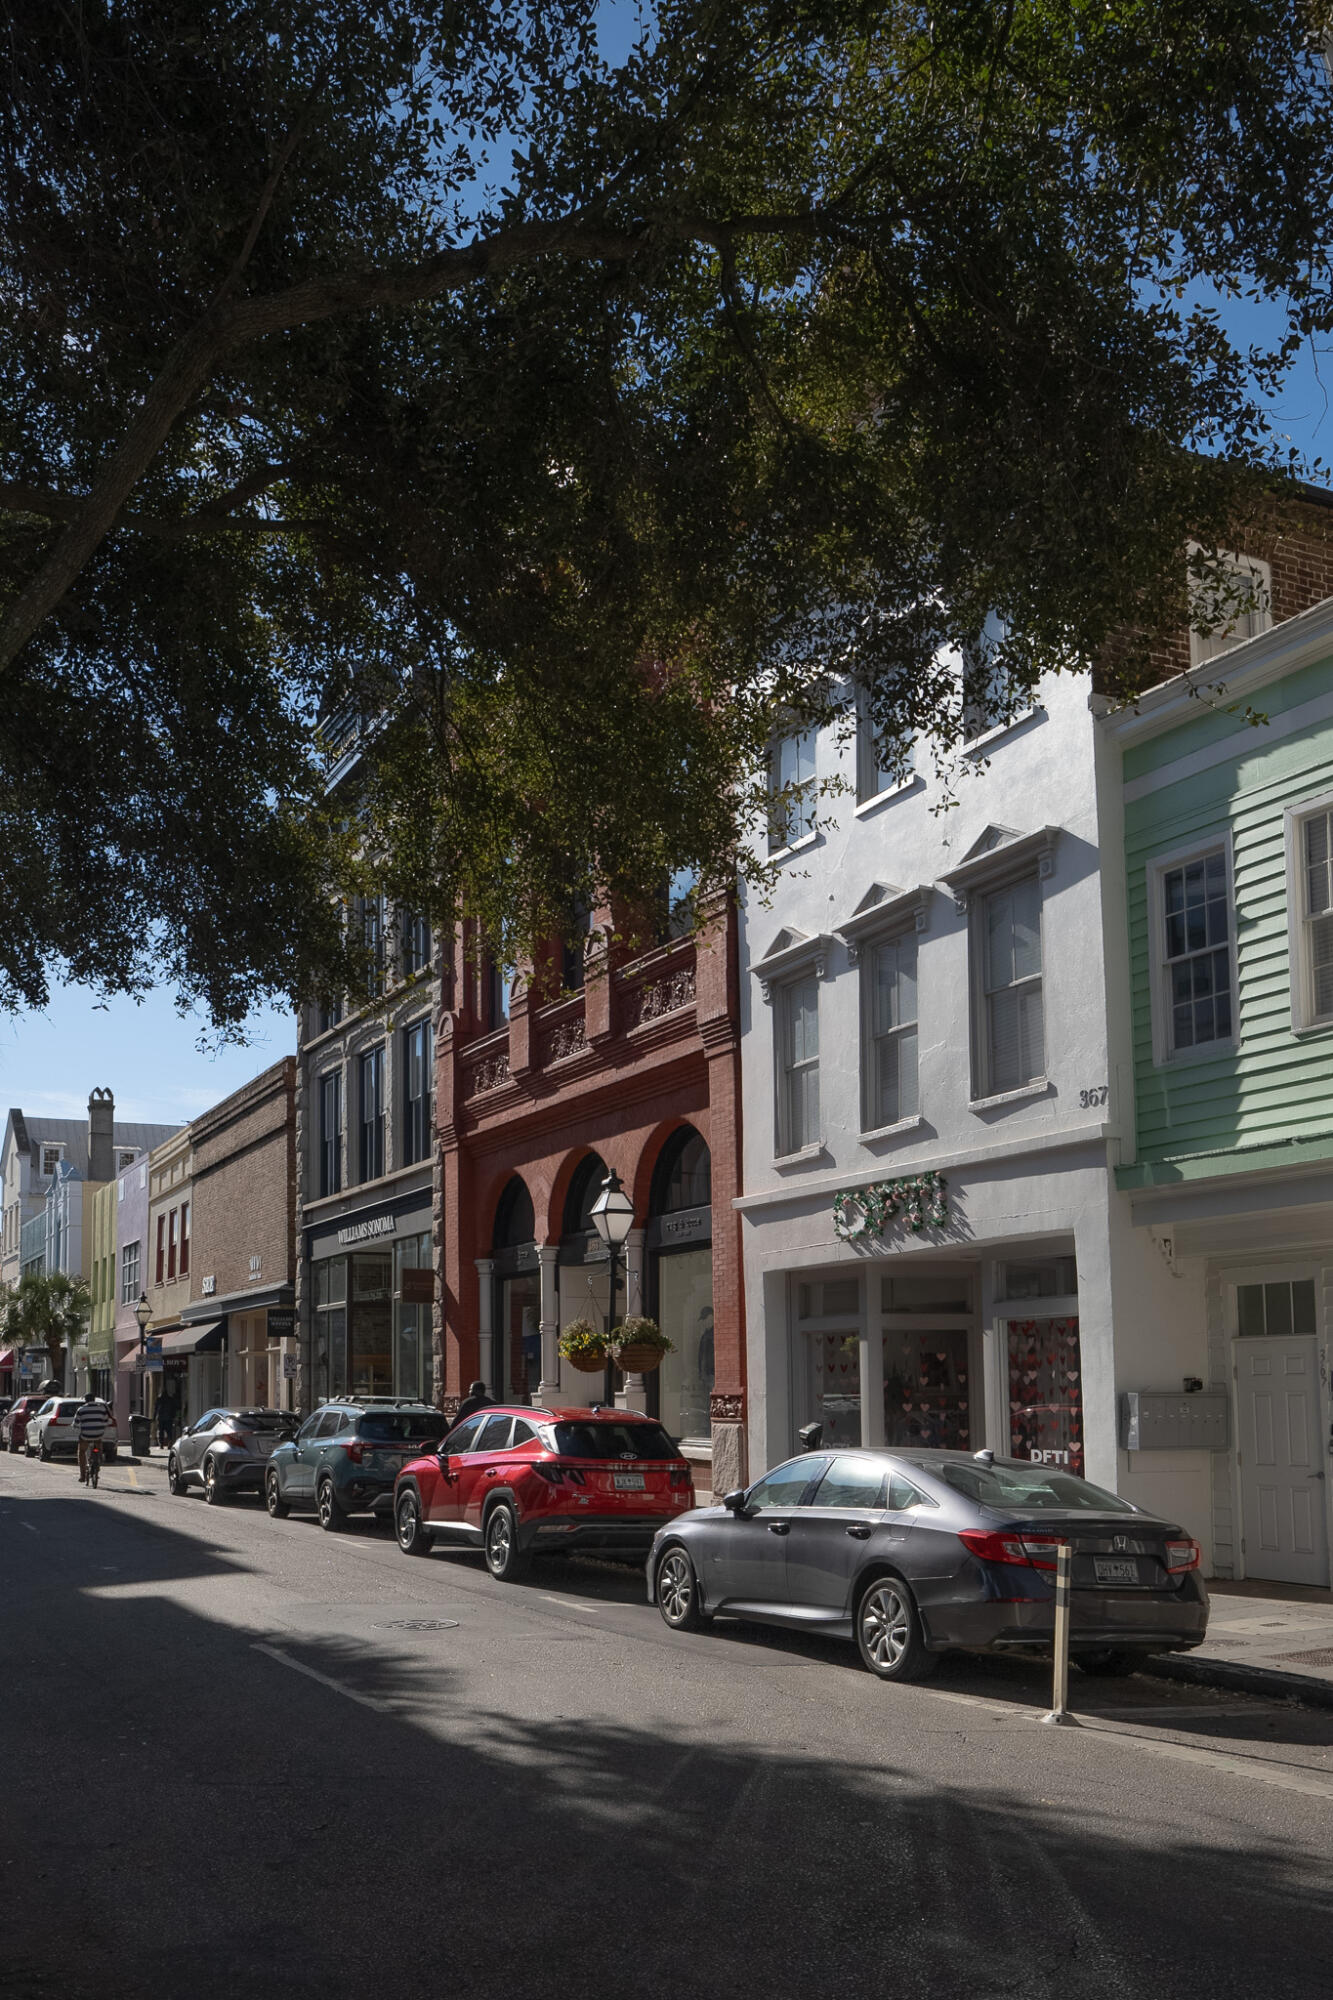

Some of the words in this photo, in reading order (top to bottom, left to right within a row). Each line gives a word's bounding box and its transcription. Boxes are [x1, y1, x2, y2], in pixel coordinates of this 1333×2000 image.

[1080, 1086, 1108, 1109] 367
[338, 1222, 368, 1244] WILLIAMS
[368, 1215, 395, 1235] SONOMA
[1030, 1449, 1069, 1464] DFTI
